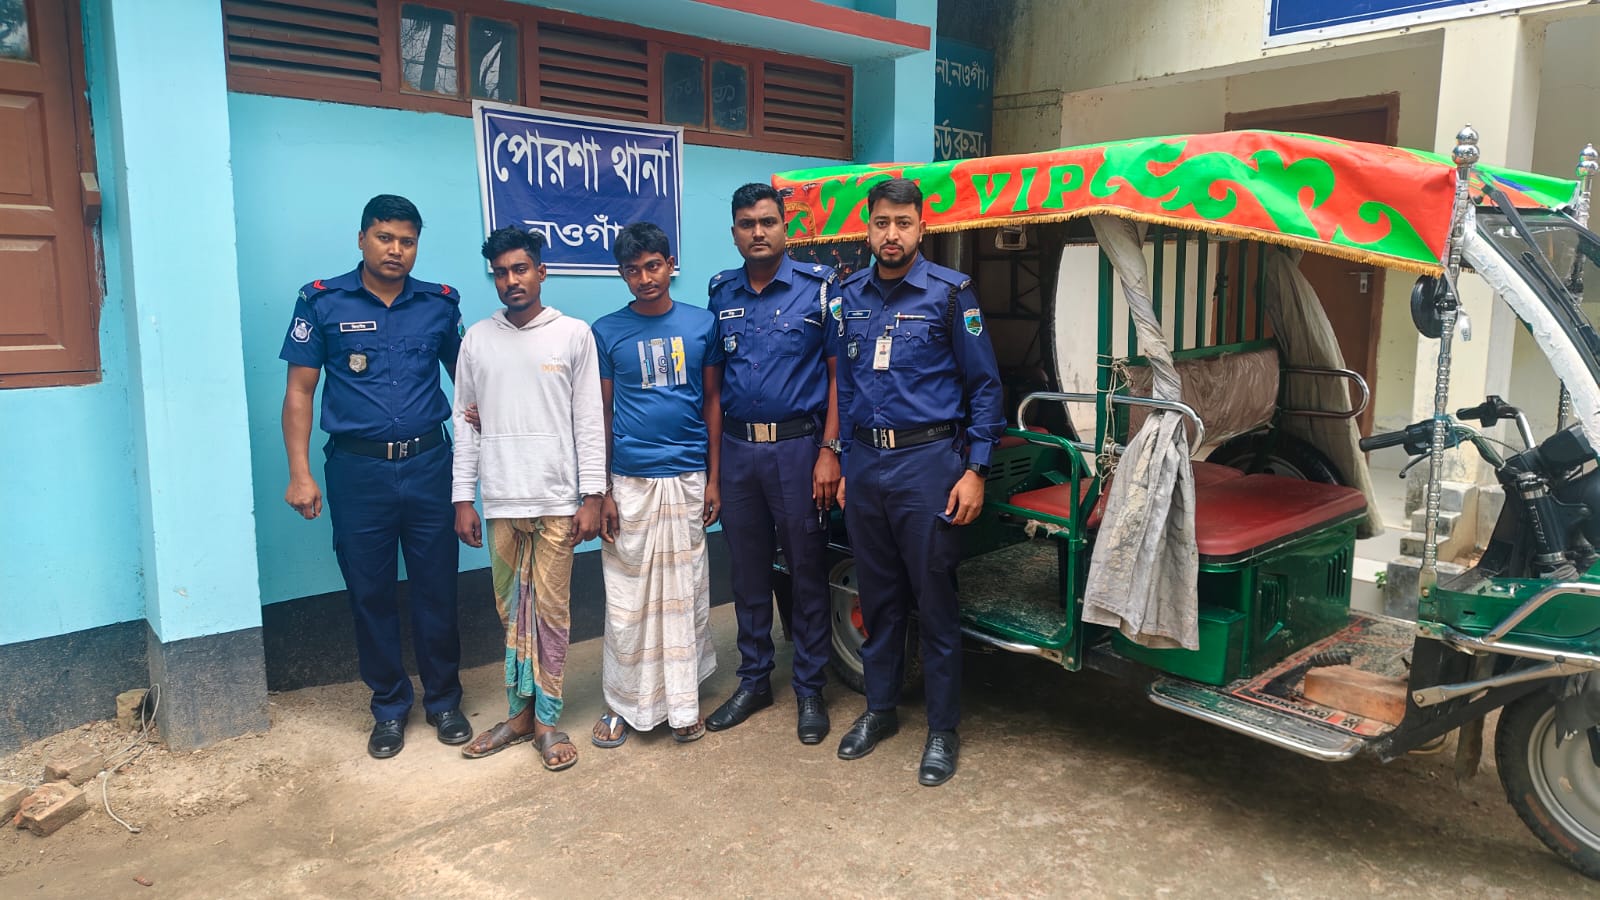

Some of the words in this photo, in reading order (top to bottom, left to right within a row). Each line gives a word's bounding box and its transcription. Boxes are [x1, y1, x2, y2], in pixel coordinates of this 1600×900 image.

[493, 129, 602, 192] পোরশা
[611, 139, 671, 197] থানা
[971, 164, 1085, 215] VIP
